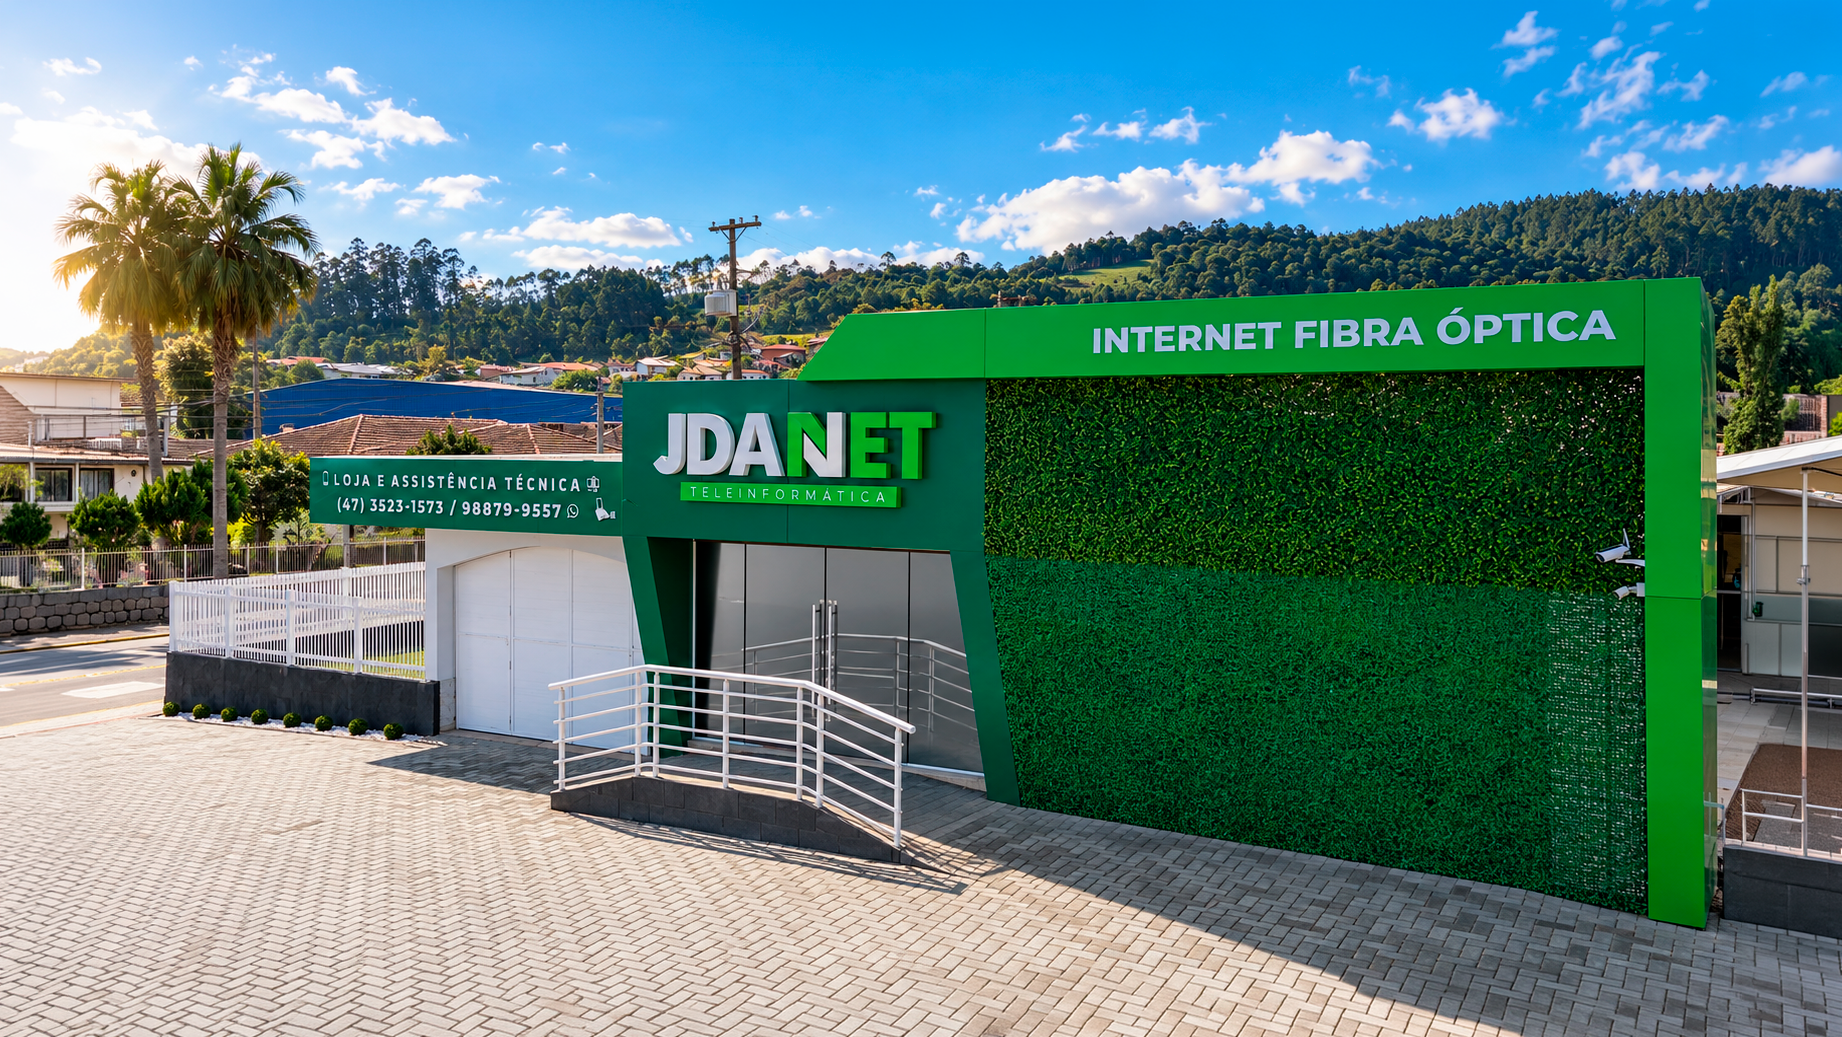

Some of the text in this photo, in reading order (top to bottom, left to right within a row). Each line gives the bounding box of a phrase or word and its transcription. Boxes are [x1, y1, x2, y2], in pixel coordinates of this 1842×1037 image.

[1092, 307, 1617, 354] INTERNET FIBRA ÓPTICA
[653, 411, 937, 480] JDANET
[334, 472, 581, 492] LOJA E ASSISTÊNCIA TÉCNICA
[690, 486, 885, 503] TELEINFORMÁTICA
[337, 497, 561, 518] (47) 3523-1573 / 98879-9557
